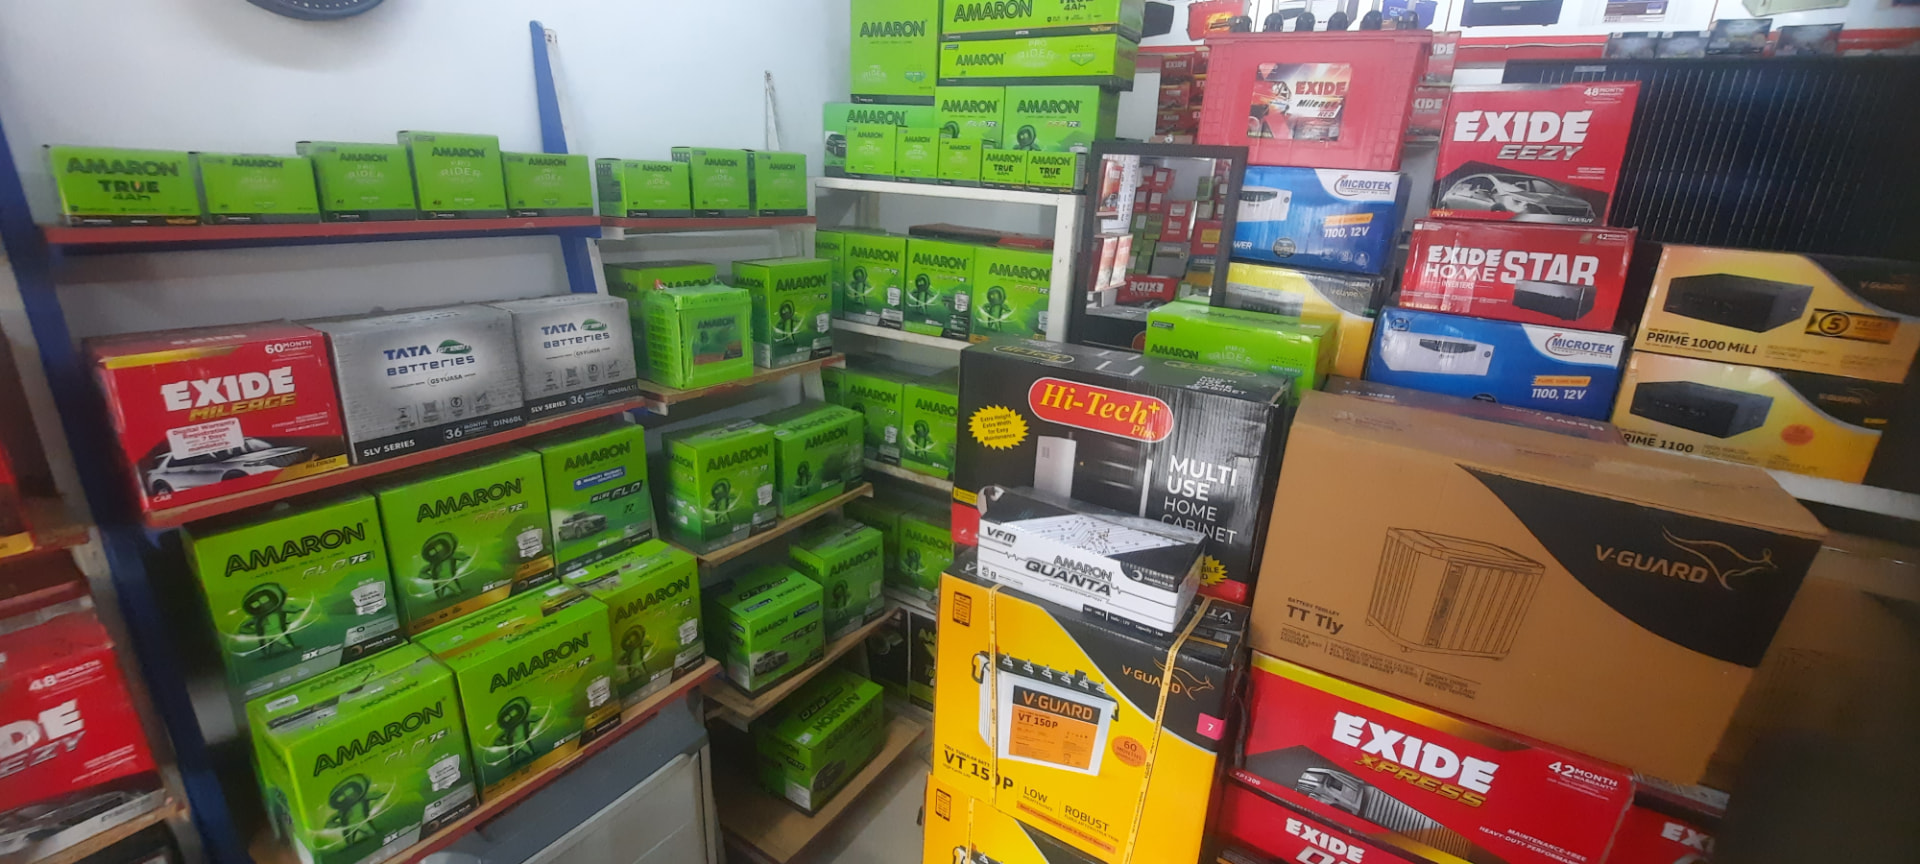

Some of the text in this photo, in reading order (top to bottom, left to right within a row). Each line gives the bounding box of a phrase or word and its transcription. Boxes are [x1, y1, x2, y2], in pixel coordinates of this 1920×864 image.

[954, 0, 1033, 22] AMARON
[860, 21, 926, 38] AMARON
[956, 53, 1005, 67] AMARON
[1295, 82, 1348, 96] EXIDE
[1584, 87, 1599, 97] 48
[942, 100, 998, 114] AMARON
[1017, 100, 1080, 114] AMARON
[1296, 99, 1343, 109] Mileage
[847, 109, 906, 125] AMARON
[1453, 110, 1594, 143] EXIDE
[857, 131, 884, 139] AMARON
[904, 136, 931, 144] AMARON
[339, 152, 388, 163] AMARON
[432, 147, 486, 158] AMARON
[528, 157, 568, 167] AMARON
[985, 153, 1024, 163] AMARON
[1030, 156, 1071, 167] AMARON
[1496, 144, 1583, 161] EEZY
[66, 157, 180, 178] AMARON
[231, 158, 285, 169] AMARON
[642, 164, 673, 173] AMARON
[704, 157, 738, 168] AMARON
[769, 162, 797, 171] AMARON
[993, 164, 1014, 173] TRUE
[1039, 167, 1061, 176] TRUE
[98, 180, 160, 193] TRUE
[1340, 180, 1393, 190] MICROTEK
[1350, 226, 1370, 237] 12V
[850, 245, 900, 264] AMARON
[912, 252, 968, 272] AMARON
[988, 262, 1051, 282] AMARON
[1425, 264, 1497, 283] HOME
[1428, 246, 1600, 287] EXIDE STAR
[776, 274, 828, 293] AMARON
[541, 323, 577, 336] TATA
[697, 317, 736, 330] AMARON
[265, 344, 284, 354] 60
[283, 340, 312, 348] MONTH
[1552, 338, 1615, 354] MICROTEK
[1647, 332, 1690, 347] PRIME
[1692, 338, 1726, 352] 1000
[383, 345, 432, 361] TATA
[1150, 344, 1199, 360] AMARON
[160, 366, 296, 412] EXIDE
[849, 384, 897, 404] AMARON
[1532, 388, 1587, 400] 1100, 12V
[188, 393, 297, 422] MILEAGE
[570, 395, 585, 405] 36
[914, 397, 957, 417] AMARO
[804, 427, 849, 451] AMARON
[1131, 424, 1158, 440] Plus
[363, 445, 382, 457] SLV
[383, 439, 416, 454] SERIES
[445, 427, 463, 441] 36
[1658, 438, 1694, 454] 1100
[563, 441, 631, 472] AMARON
[706, 444, 770, 472] AMARON
[1168, 454, 1238, 487] MULTI
[153, 493, 173, 503] CAR
[1166, 477, 1210, 502] USE
[416, 477, 523, 524] AMARON
[1163, 495, 1218, 523] HOME
[904, 526, 953, 552] AMARON
[986, 526, 1017, 544] VFM
[225, 521, 366, 578] AMARON
[828, 546, 880, 578] AMARON
[1053, 555, 1113, 582] AMARON
[1595, 544, 1709, 584] V-GUARD
[1024, 560, 1112, 597] QUANTA
[615, 575, 691, 624] AMARON
[1287, 603, 1311, 622] TT
[490, 631, 590, 694] AMARON
[28, 674, 57, 691] 48
[1121, 664, 1182, 695] V-GUAD
[1022, 690, 1093, 721] V-GUARD
[1018, 712, 1031, 723] VT
[314, 700, 445, 777] AMARON
[1123, 740, 1138, 753] 60
[943, 749, 967, 770] VT
[1331, 711, 1501, 795] EXIDE
[1354, 752, 1488, 808] XPRESS
[1548, 761, 1619, 788] 42 MONTH
[1023, 785, 1048, 804] LOW
[1064, 804, 1110, 833] ROBUST
[1285, 816, 1367, 864] EXIDE
